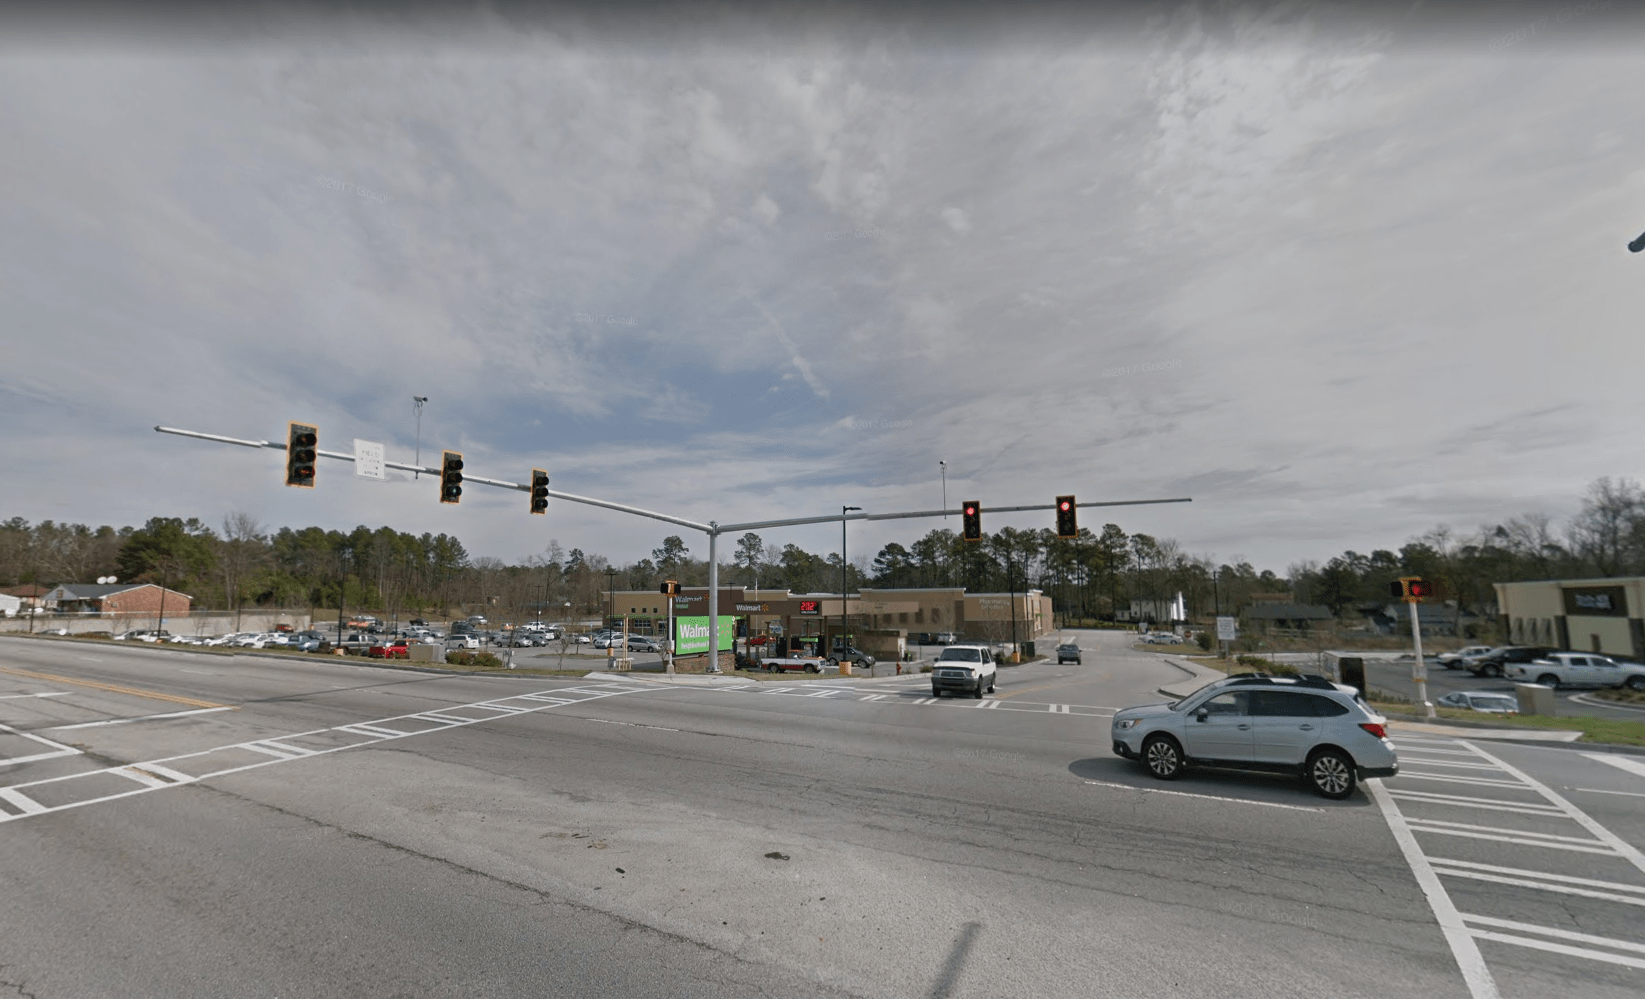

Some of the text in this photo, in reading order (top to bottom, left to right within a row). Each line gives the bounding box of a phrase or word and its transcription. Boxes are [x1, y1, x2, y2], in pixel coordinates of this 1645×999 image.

[675, 595, 703, 603] Walmart
[736, 604, 761, 612] Walmart
[680, 624, 719, 639] Walma
